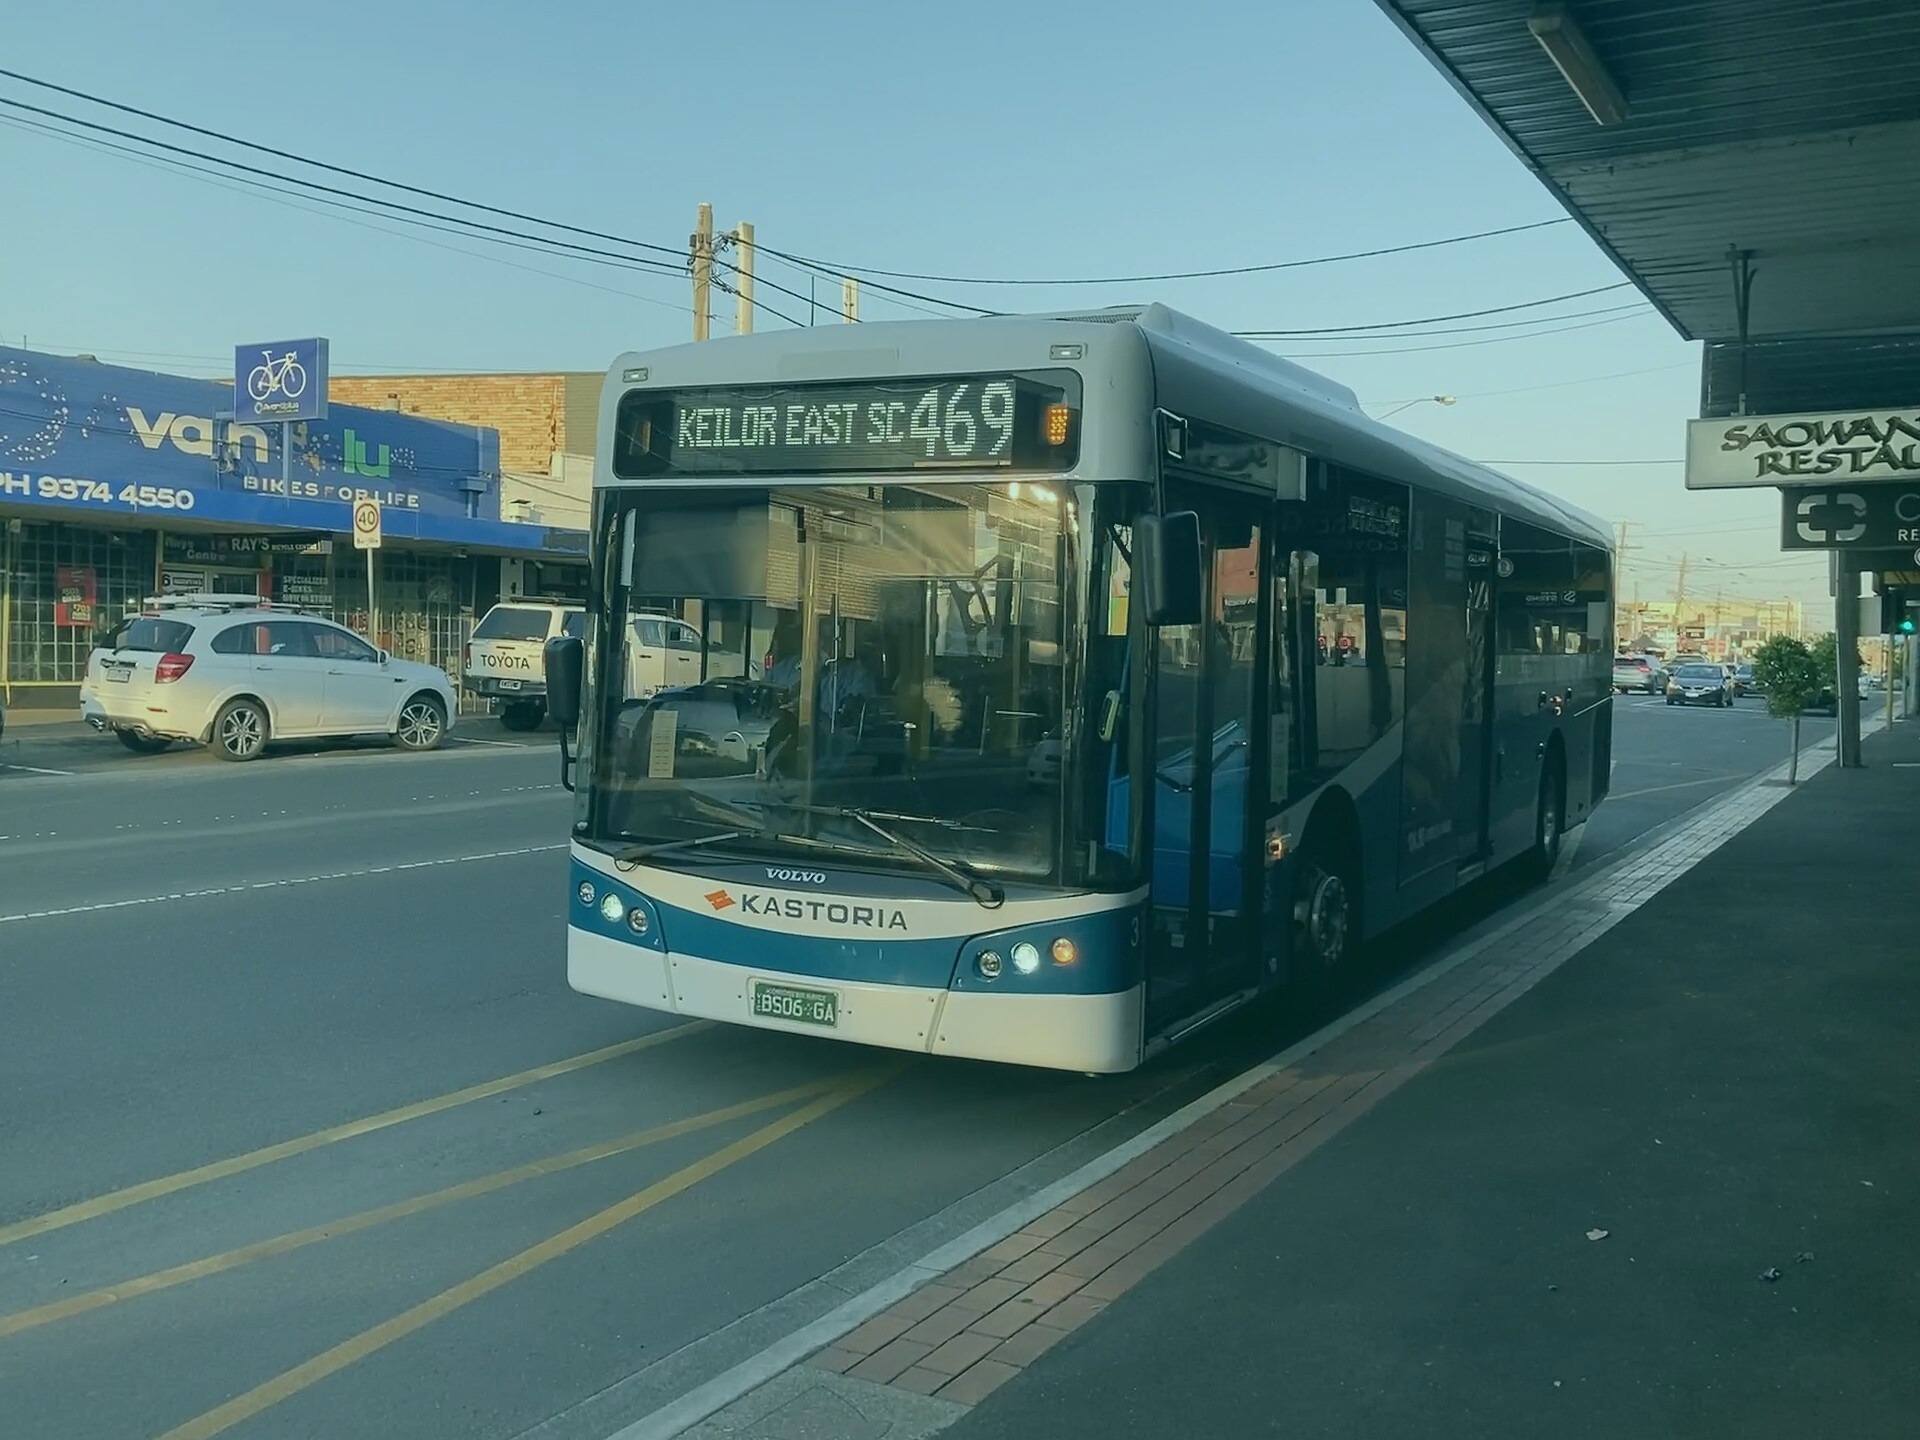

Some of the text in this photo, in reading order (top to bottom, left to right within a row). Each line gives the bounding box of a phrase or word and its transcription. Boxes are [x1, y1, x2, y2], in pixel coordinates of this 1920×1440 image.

[678, 382, 1014, 456] KEILOR EAST SC 469
[0, 473, 195, 510] H 9374 4550
[244, 476, 319, 496] BIKES
[375, 490, 419, 508] LIFE
[359, 511, 376, 525] 40
[232, 538, 270, 551] RAY'S
[480, 654, 530, 669] TOYOTA
[765, 867, 827, 884] VOLVO
[741, 894, 908, 930] KASTORIA
